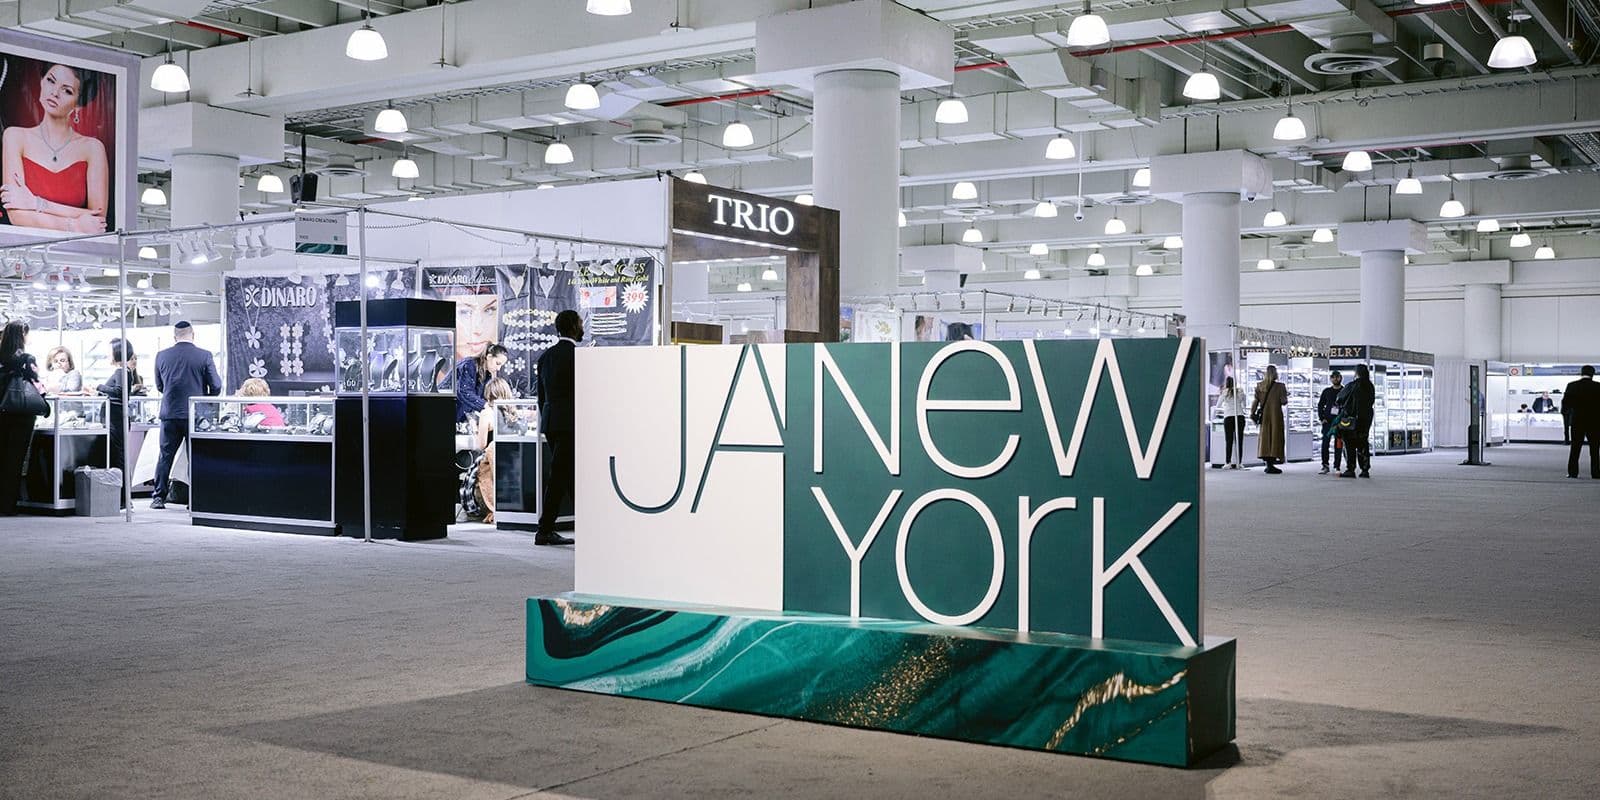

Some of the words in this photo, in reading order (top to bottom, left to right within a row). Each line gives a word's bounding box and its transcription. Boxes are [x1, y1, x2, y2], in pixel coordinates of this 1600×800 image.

[708, 194, 795, 236] TRIO
[261, 286, 317, 307] DINARO
[437, 274, 468, 285] DINARO
[609, 343, 786, 514] JA
[813, 336, 1193, 479] New
[811, 488, 1201, 648] York
